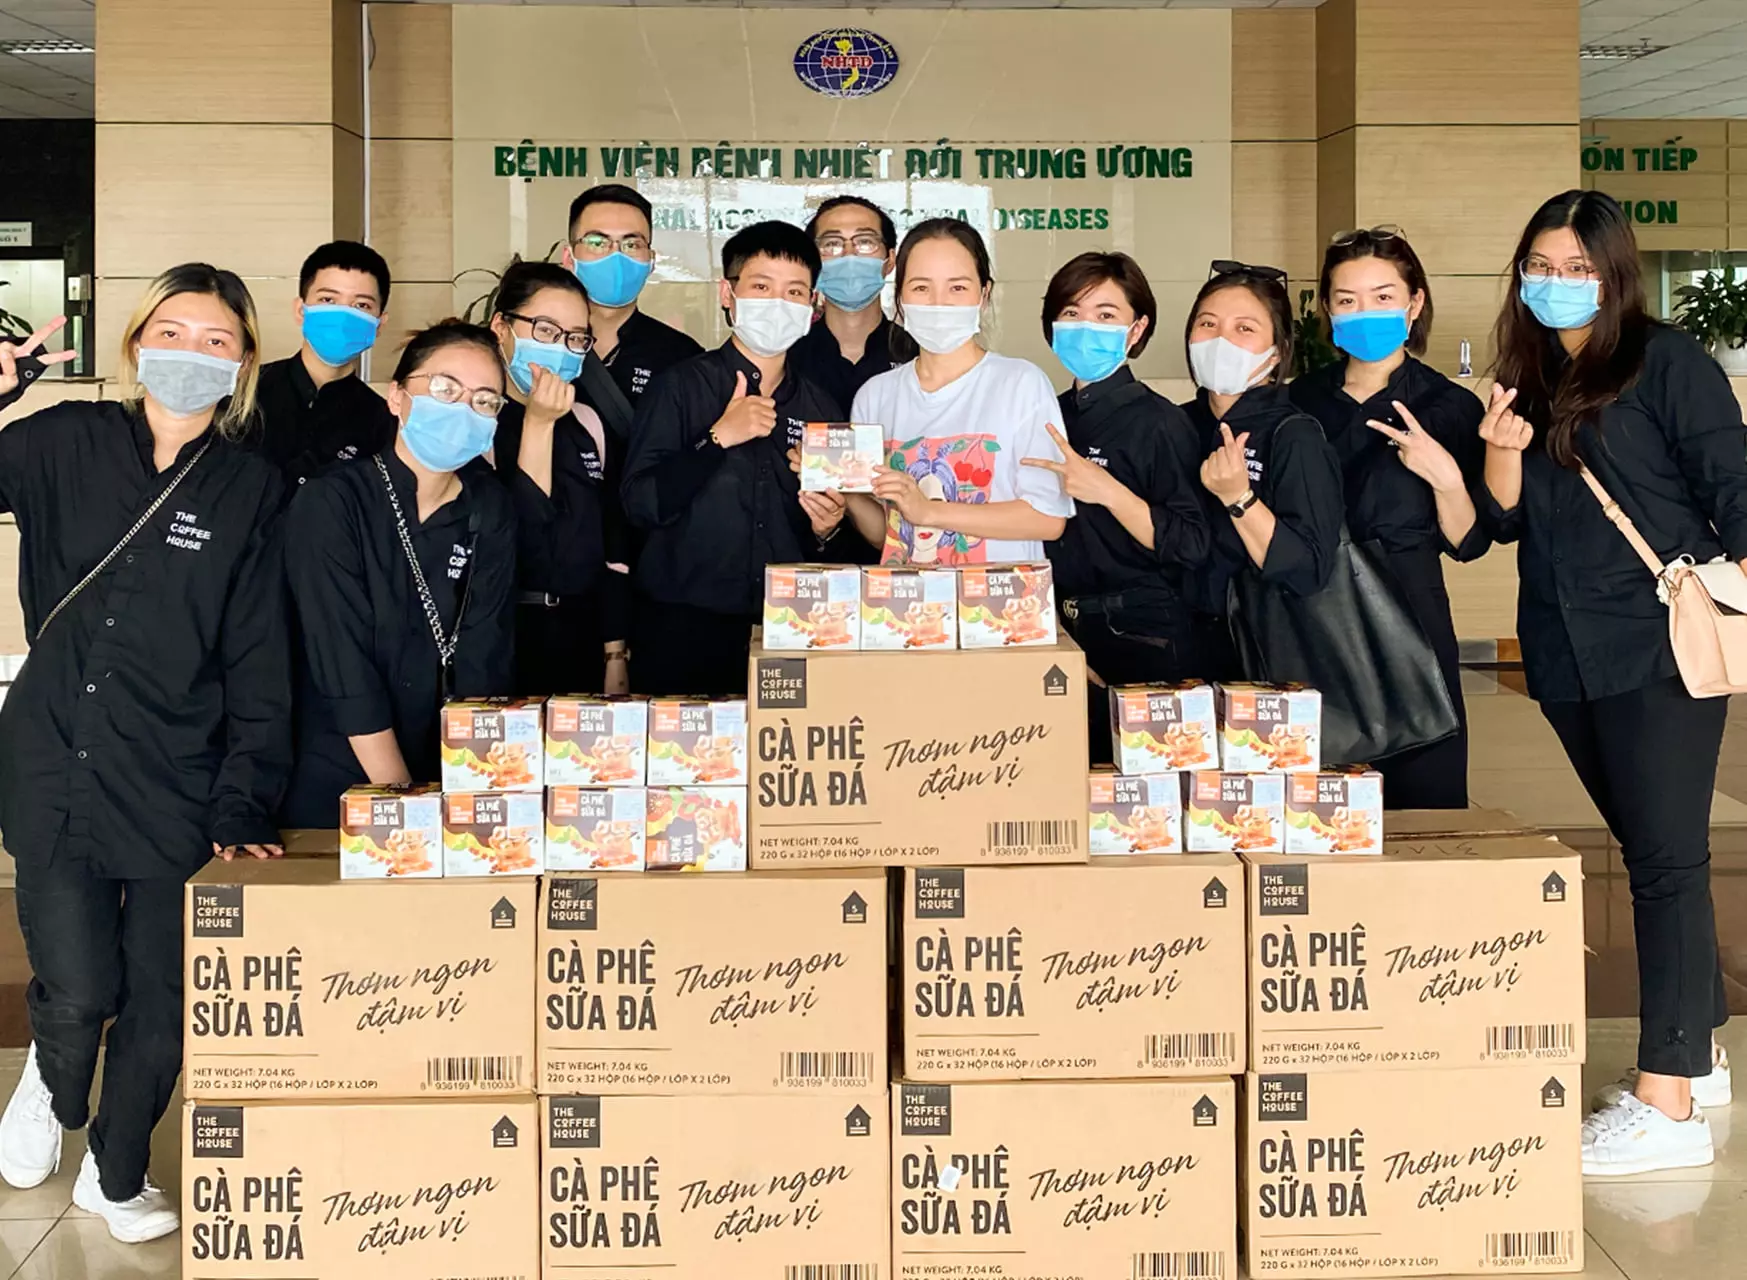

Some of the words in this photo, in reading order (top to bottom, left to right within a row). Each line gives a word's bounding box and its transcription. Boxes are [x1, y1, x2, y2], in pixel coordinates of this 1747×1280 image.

[821, 55, 873, 69] NHTD
[976, 148, 1087, 180] TRUNG
[1632, 136, 1698, 172] TIẾP
[993, 207, 1110, 231] DISEASES
[170, 523, 212, 540] COFFEE
[175, 511, 197, 524] THE
[166, 535, 203, 551] HOUSE
[762, 669, 781, 678] THE
[762, 679, 803, 689] COFFEE
[762, 690, 797, 700] HOUSE
[758, 718, 796, 762] CÀ
[807, 715, 865, 761] PHÊ
[883, 738, 966, 772] Thơm
[969, 722, 1053, 761] ngon
[758, 763, 817, 807] SỮA
[827, 762, 867, 806] ĐÁ
[917, 764, 991, 801] đậm
[994, 757, 1024, 788] vị
[552, 890, 571, 898] THE
[920, 879, 939, 887] THE
[920, 889, 961, 898] COFFEE
[1264, 876, 1283, 885] THE
[1264, 886, 1305, 896] COFFEE
[197, 897, 217, 906] THE
[197, 908, 239, 917] COFFEE
[552, 900, 593, 909] COFFEE
[552, 911, 587, 920] HOUSE
[920, 900, 954, 909] HOUSE
[1264, 897, 1299, 906] HOUSE
[197, 918, 232, 928] HOUSE
[547, 939, 586, 984] CÀ
[597, 939, 656, 984] PHÊ
[915, 928, 954, 972] CÀ
[965, 926, 1023, 972] PHÊ
[1041, 951, 1125, 983] Thơm
[1128, 935, 1212, 974] ngon
[1260, 924, 1299, 968] CÀ
[1309, 922, 1367, 967] PHÊ
[1384, 944, 1466, 977] Thơm
[1469, 928, 1551, 967] ngon
[193, 947, 232, 991] CÀ
[243, 946, 303, 991] PHÊ
[321, 972, 407, 1003] Thơm
[411, 956, 498, 995] ngon
[674, 965, 760, 997] Thơm
[764, 950, 851, 989] ngon
[1418, 969, 1491, 1006] đậm
[1493, 962, 1523, 993] vị
[547, 986, 606, 1030] SỮA
[617, 987, 657, 1031] ĐÁ
[709, 992, 785, 1028] đậm
[788, 985, 820, 1017] vị
[915, 974, 975, 1018] SỮA
[985, 973, 1025, 1017] ĐÁ
[1076, 976, 1149, 1013] đậm
[1152, 970, 1182, 1000] vị
[1261, 969, 1319, 1013] SỮA
[1329, 968, 1369, 1011] ĐÁ
[193, 994, 253, 1037] SỮA
[263, 994, 304, 1037] ĐÁ
[356, 998, 432, 1034] đậm
[436, 991, 467, 1022] vị
[547, 1062, 565, 1070] NET
[611, 1062, 631, 1071] 7.04
[634, 1062, 648, 1071] KG
[916, 1049, 934, 1058] NET
[980, 1048, 1000, 1056] 7.04
[1003, 1048, 1016, 1056] KG
[547, 1074, 564, 1082] 220
[567, 1074, 574, 1083] G
[585, 1074, 595, 1083] 32
[700, 1075, 705, 1083] 2
[1263, 1082, 1282, 1091] THE
[554, 1108, 574, 1117] THE
[906, 1097, 926, 1105] THE
[906, 1107, 948, 1116] COFFEE
[1263, 1092, 1303, 1102] COFFEE
[1263, 1102, 1297, 1112] HOUSE
[198, 1118, 217, 1126] THE
[198, 1128, 240, 1138] COFFEE
[554, 1118, 596, 1128] COFFEE
[554, 1129, 590, 1139] HOUSE
[906, 1117, 941, 1127] HOUSE
[197, 1139, 233, 1149] HOUSE
[1259, 1130, 1297, 1174] CÀ
[1308, 1128, 1365, 1173] PHÊ
[1382, 1151, 1465, 1183] Thơm
[1467, 1134, 1551, 1173] ngon
[550, 1157, 589, 1202] CÀ
[601, 1156, 660, 1202] PHÊ
[902, 1145, 940, 1189] CÀ
[952, 1144, 1010, 1189] PHÊ
[1028, 1169, 1113, 1201] Thơm
[1116, 1153, 1201, 1192] ngon
[192, 1168, 232, 1213] CÀ
[243, 1166, 304, 1213] PHÊ
[322, 1191, 409, 1225] Thơm
[413, 1174, 501, 1215] ngon
[678, 1180, 765, 1213] Thơm
[768, 1163, 854, 1203] ngon
[1259, 1175, 1318, 1219] SỮA
[1327, 1174, 1367, 1217] ĐÁ
[1416, 1175, 1489, 1212] đậm
[1492, 1168, 1522, 1199] vị
[550, 1204, 610, 1248] SỮA
[621, 1203, 662, 1247] ĐÁ
[714, 1206, 790, 1243] đậm
[793, 1199, 824, 1230] vị
[901, 1191, 961, 1235] SỮA
[971, 1191, 1011, 1234] ĐÁ
[1063, 1194, 1138, 1231] đậm
[1141, 1188, 1172, 1218] vị
[192, 1215, 253, 1260] SỮA
[263, 1215, 305, 1260] ĐÁ
[358, 1218, 435, 1256] đậm
[438, 1211, 470, 1243] vị
